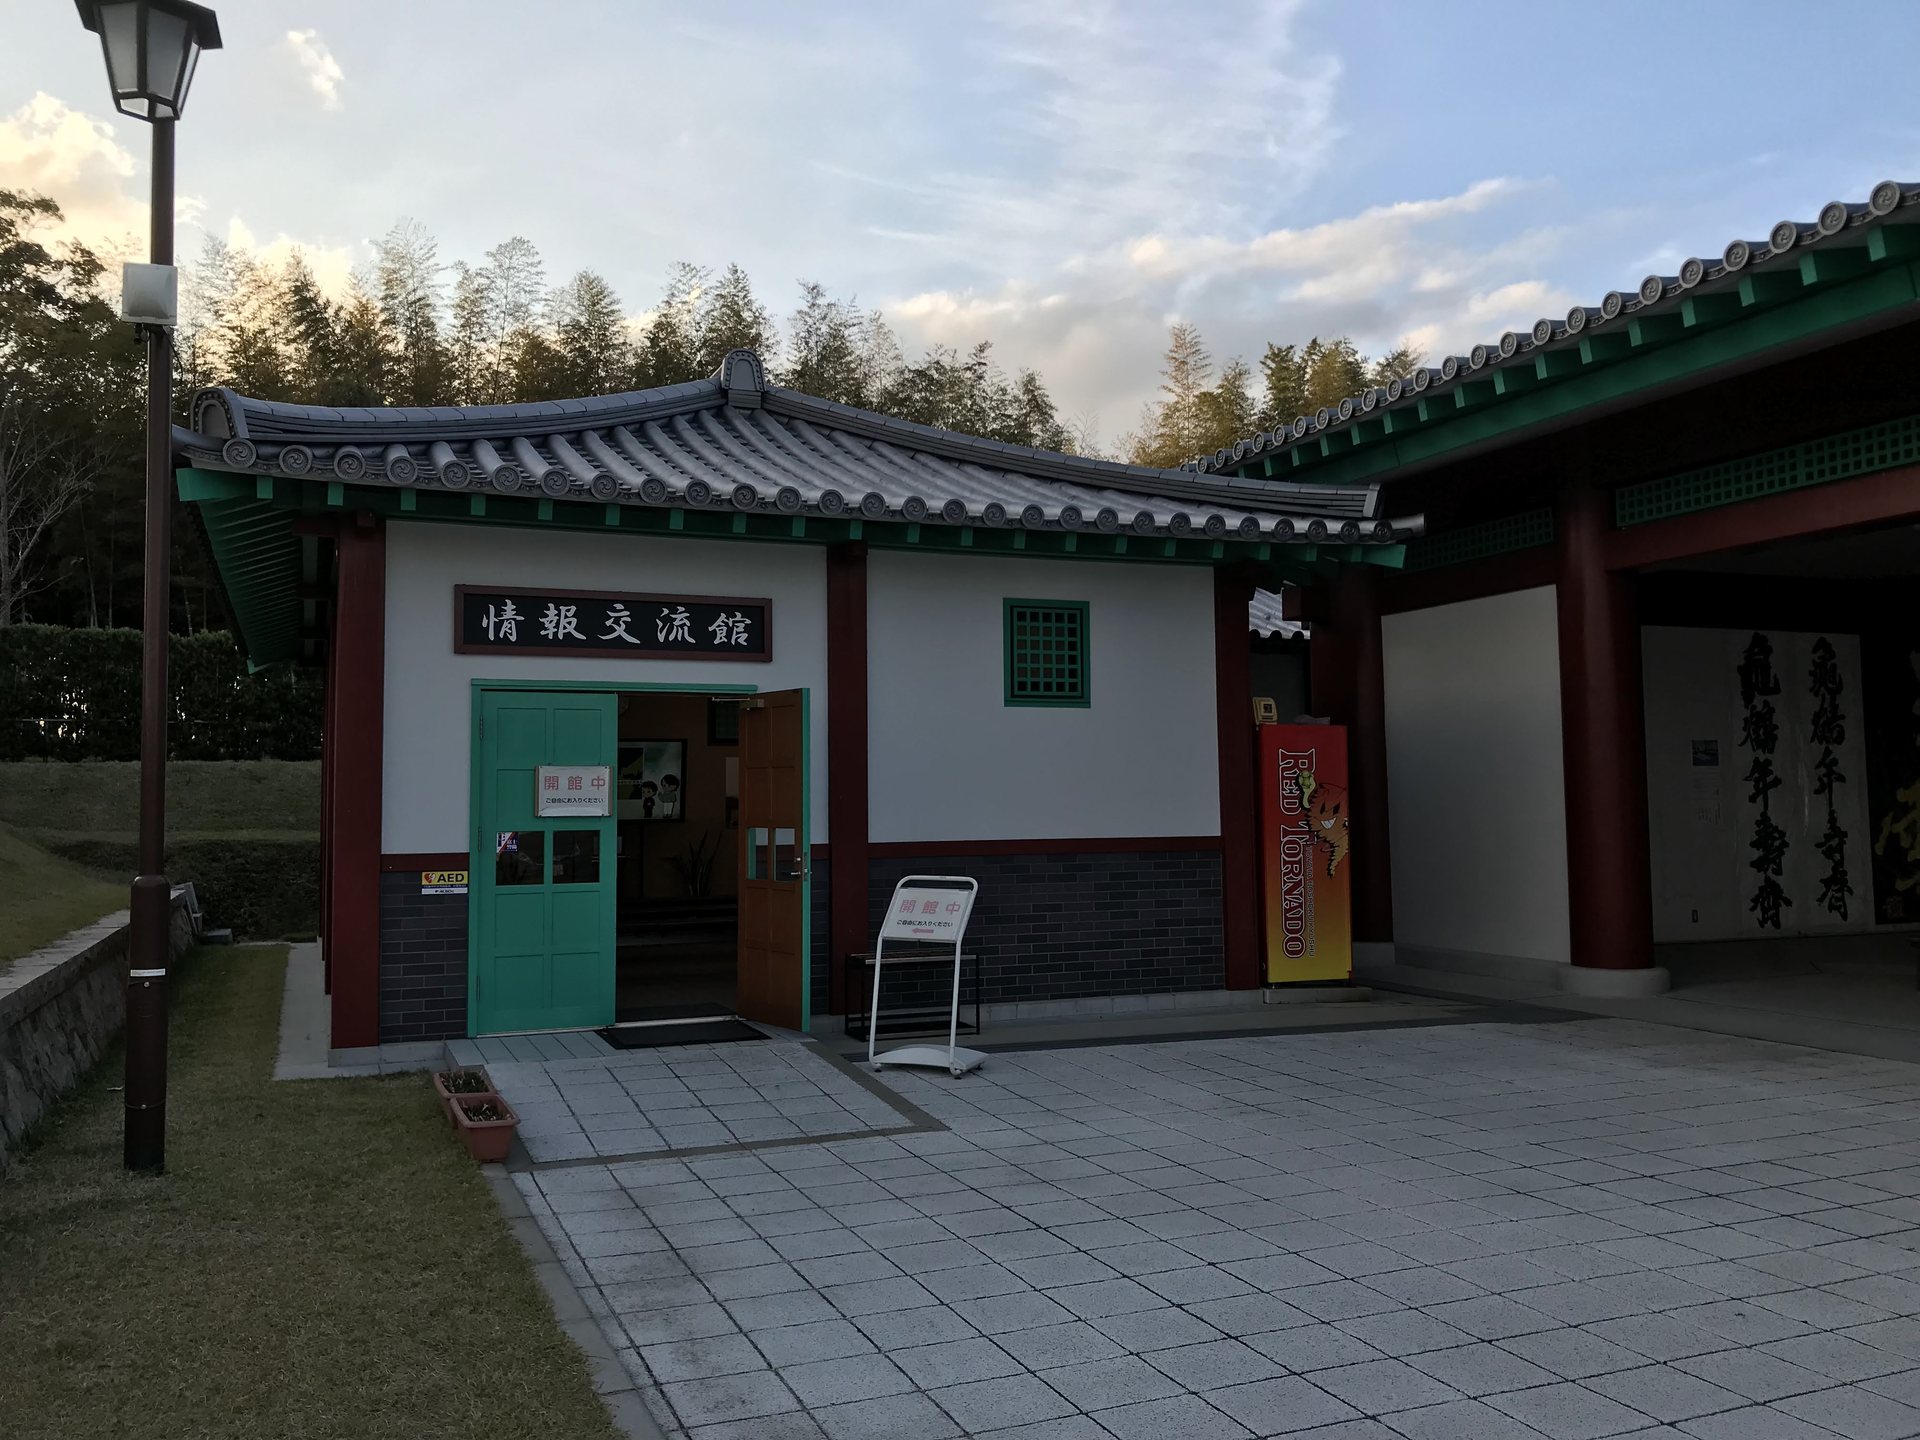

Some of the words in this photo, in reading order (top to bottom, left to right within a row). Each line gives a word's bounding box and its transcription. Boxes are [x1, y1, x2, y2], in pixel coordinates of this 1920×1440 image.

[481, 599, 752, 646] 情報交流館
[544, 775, 606, 790] 開館中
[1278, 748, 1316, 815] RED
[437, 873, 464, 883] AED
[1281, 822, 1316, 958] TORNADO
[900, 900, 961, 915] 開館中
[897, 920, 953, 928] ご自由にお入りください
